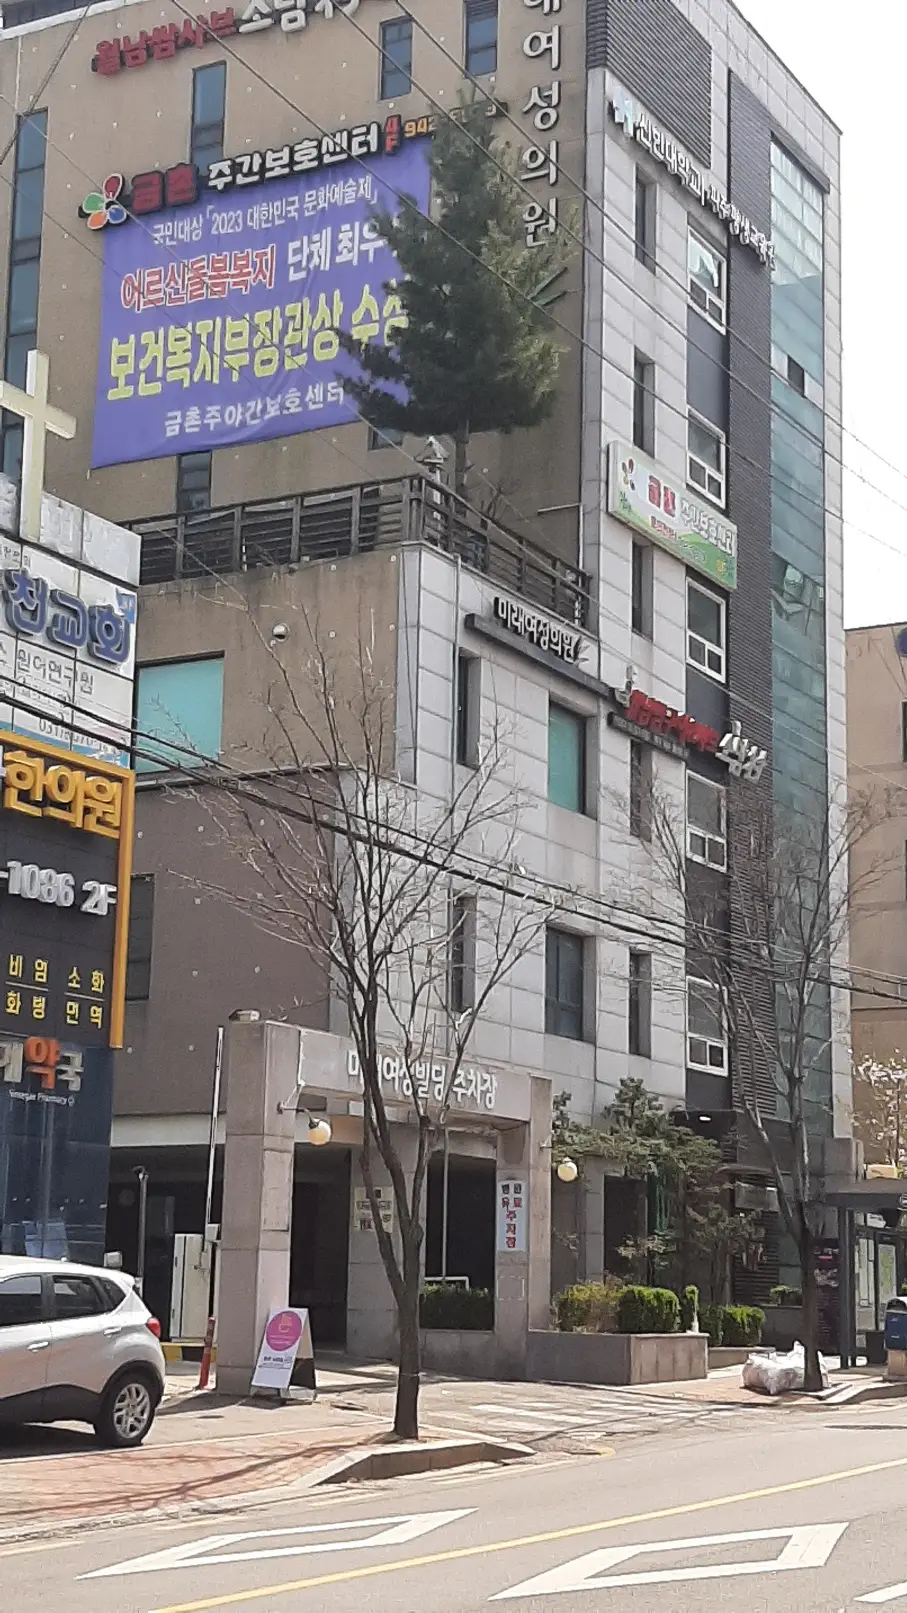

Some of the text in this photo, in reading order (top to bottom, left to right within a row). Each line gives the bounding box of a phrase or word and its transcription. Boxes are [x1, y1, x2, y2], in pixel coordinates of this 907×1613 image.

[207, 121, 379, 191] 주간보호센터
[152, 214, 203, 246] 국민대상
[247, 196, 300, 231] 대한민국
[121, 244, 276, 313] 어르신돌봄복지
[287, 226, 332, 282] 단체
[107, 288, 344, 400] 보건복지부장관상
[498, 598, 575, 663] 미래여성의원
[4, 751, 122, 839] 한의원
[80, 880, 117, 916] 2F
[348, 1050, 498, 1110] 미여성빌딩 주차장
